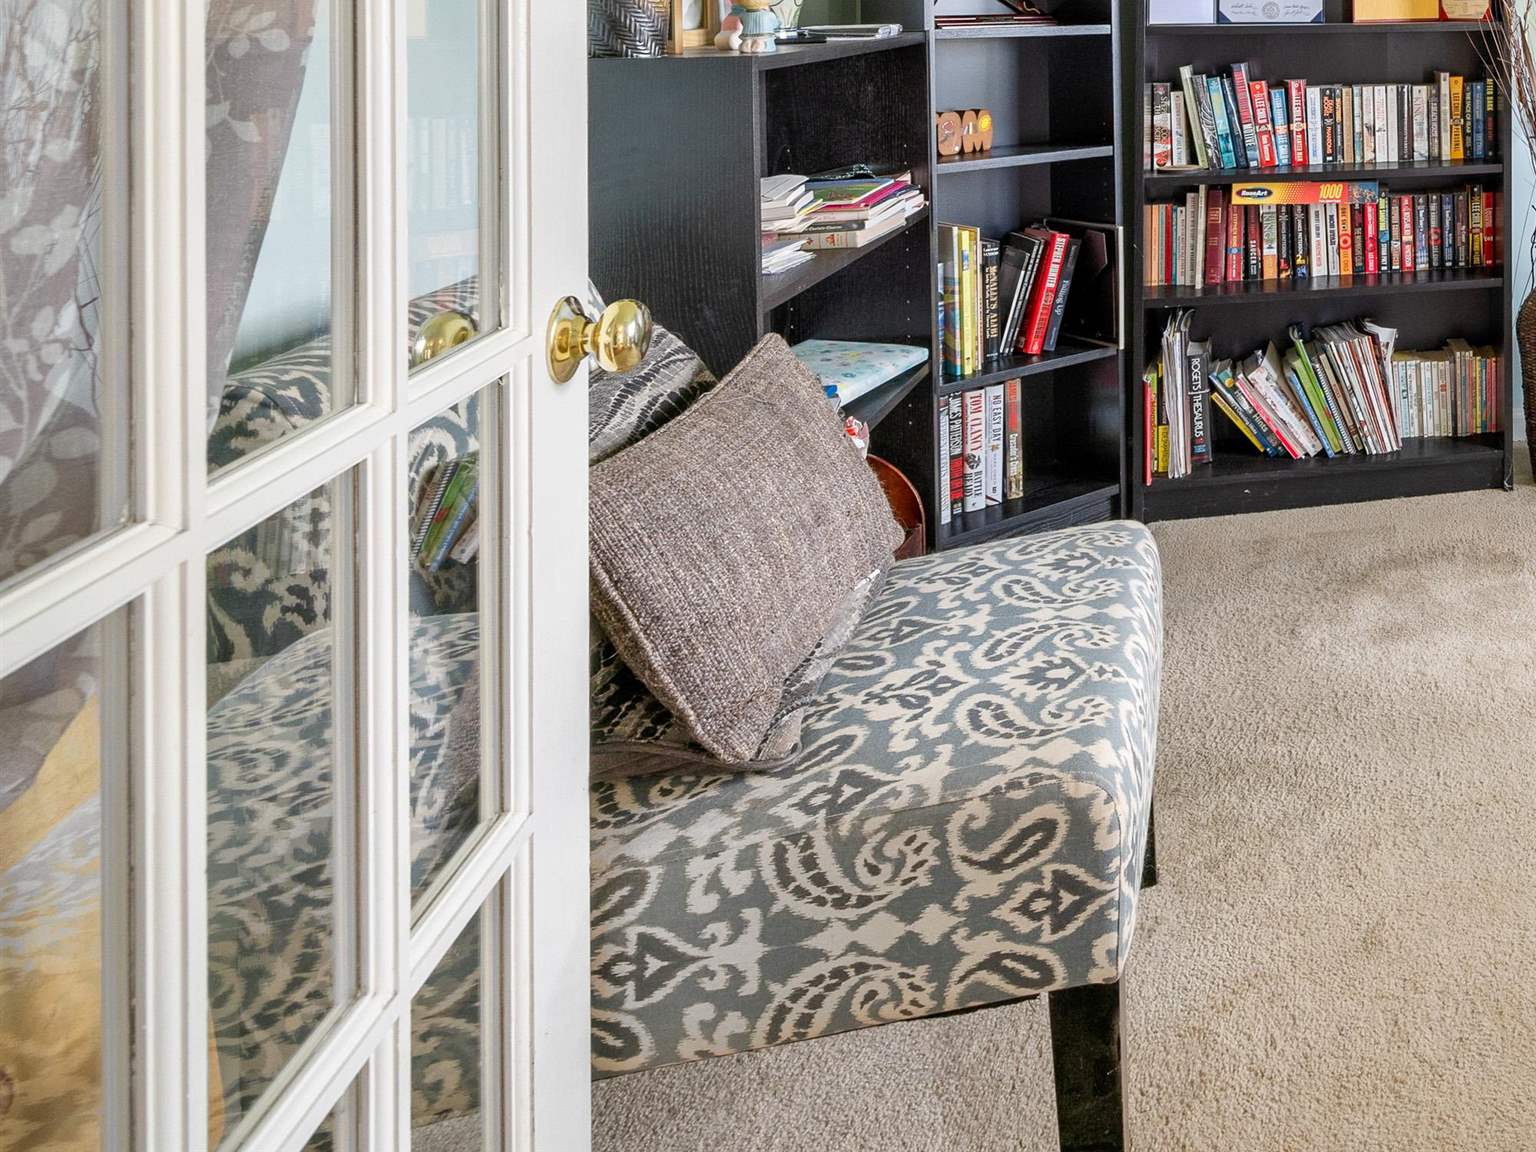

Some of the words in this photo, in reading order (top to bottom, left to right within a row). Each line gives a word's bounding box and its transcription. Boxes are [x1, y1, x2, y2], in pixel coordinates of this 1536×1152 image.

[1256, 98, 1266, 108] LEE
[1256, 108, 1266, 123] CHILD
[1319, 183, 1343, 199] 1000
[1263, 214, 1274, 239] KING
[1052, 237, 1066, 263] STEPHEN
[1249, 240, 1257, 264] SAUCER
[989, 265, 998, 309] McNALLY'S
[1047, 264, 1060, 288] HUNTER
[1055, 279, 1070, 304] Falling
[990, 313, 998, 338] ALIBI
[949, 397, 961, 420] JAMES
[969, 393, 982, 415] TOM
[992, 395, 1001, 406] NO
[992, 407, 1002, 427] EASY
[1192, 395, 1204, 437] THESAURUS
[1253, 412, 1269, 432] Hints
[949, 419, 962, 456] PATTERSON
[970, 418, 983, 452] CLANCY
[992, 428, 1001, 442] DAY
[973, 470, 982, 497] BATTLE
